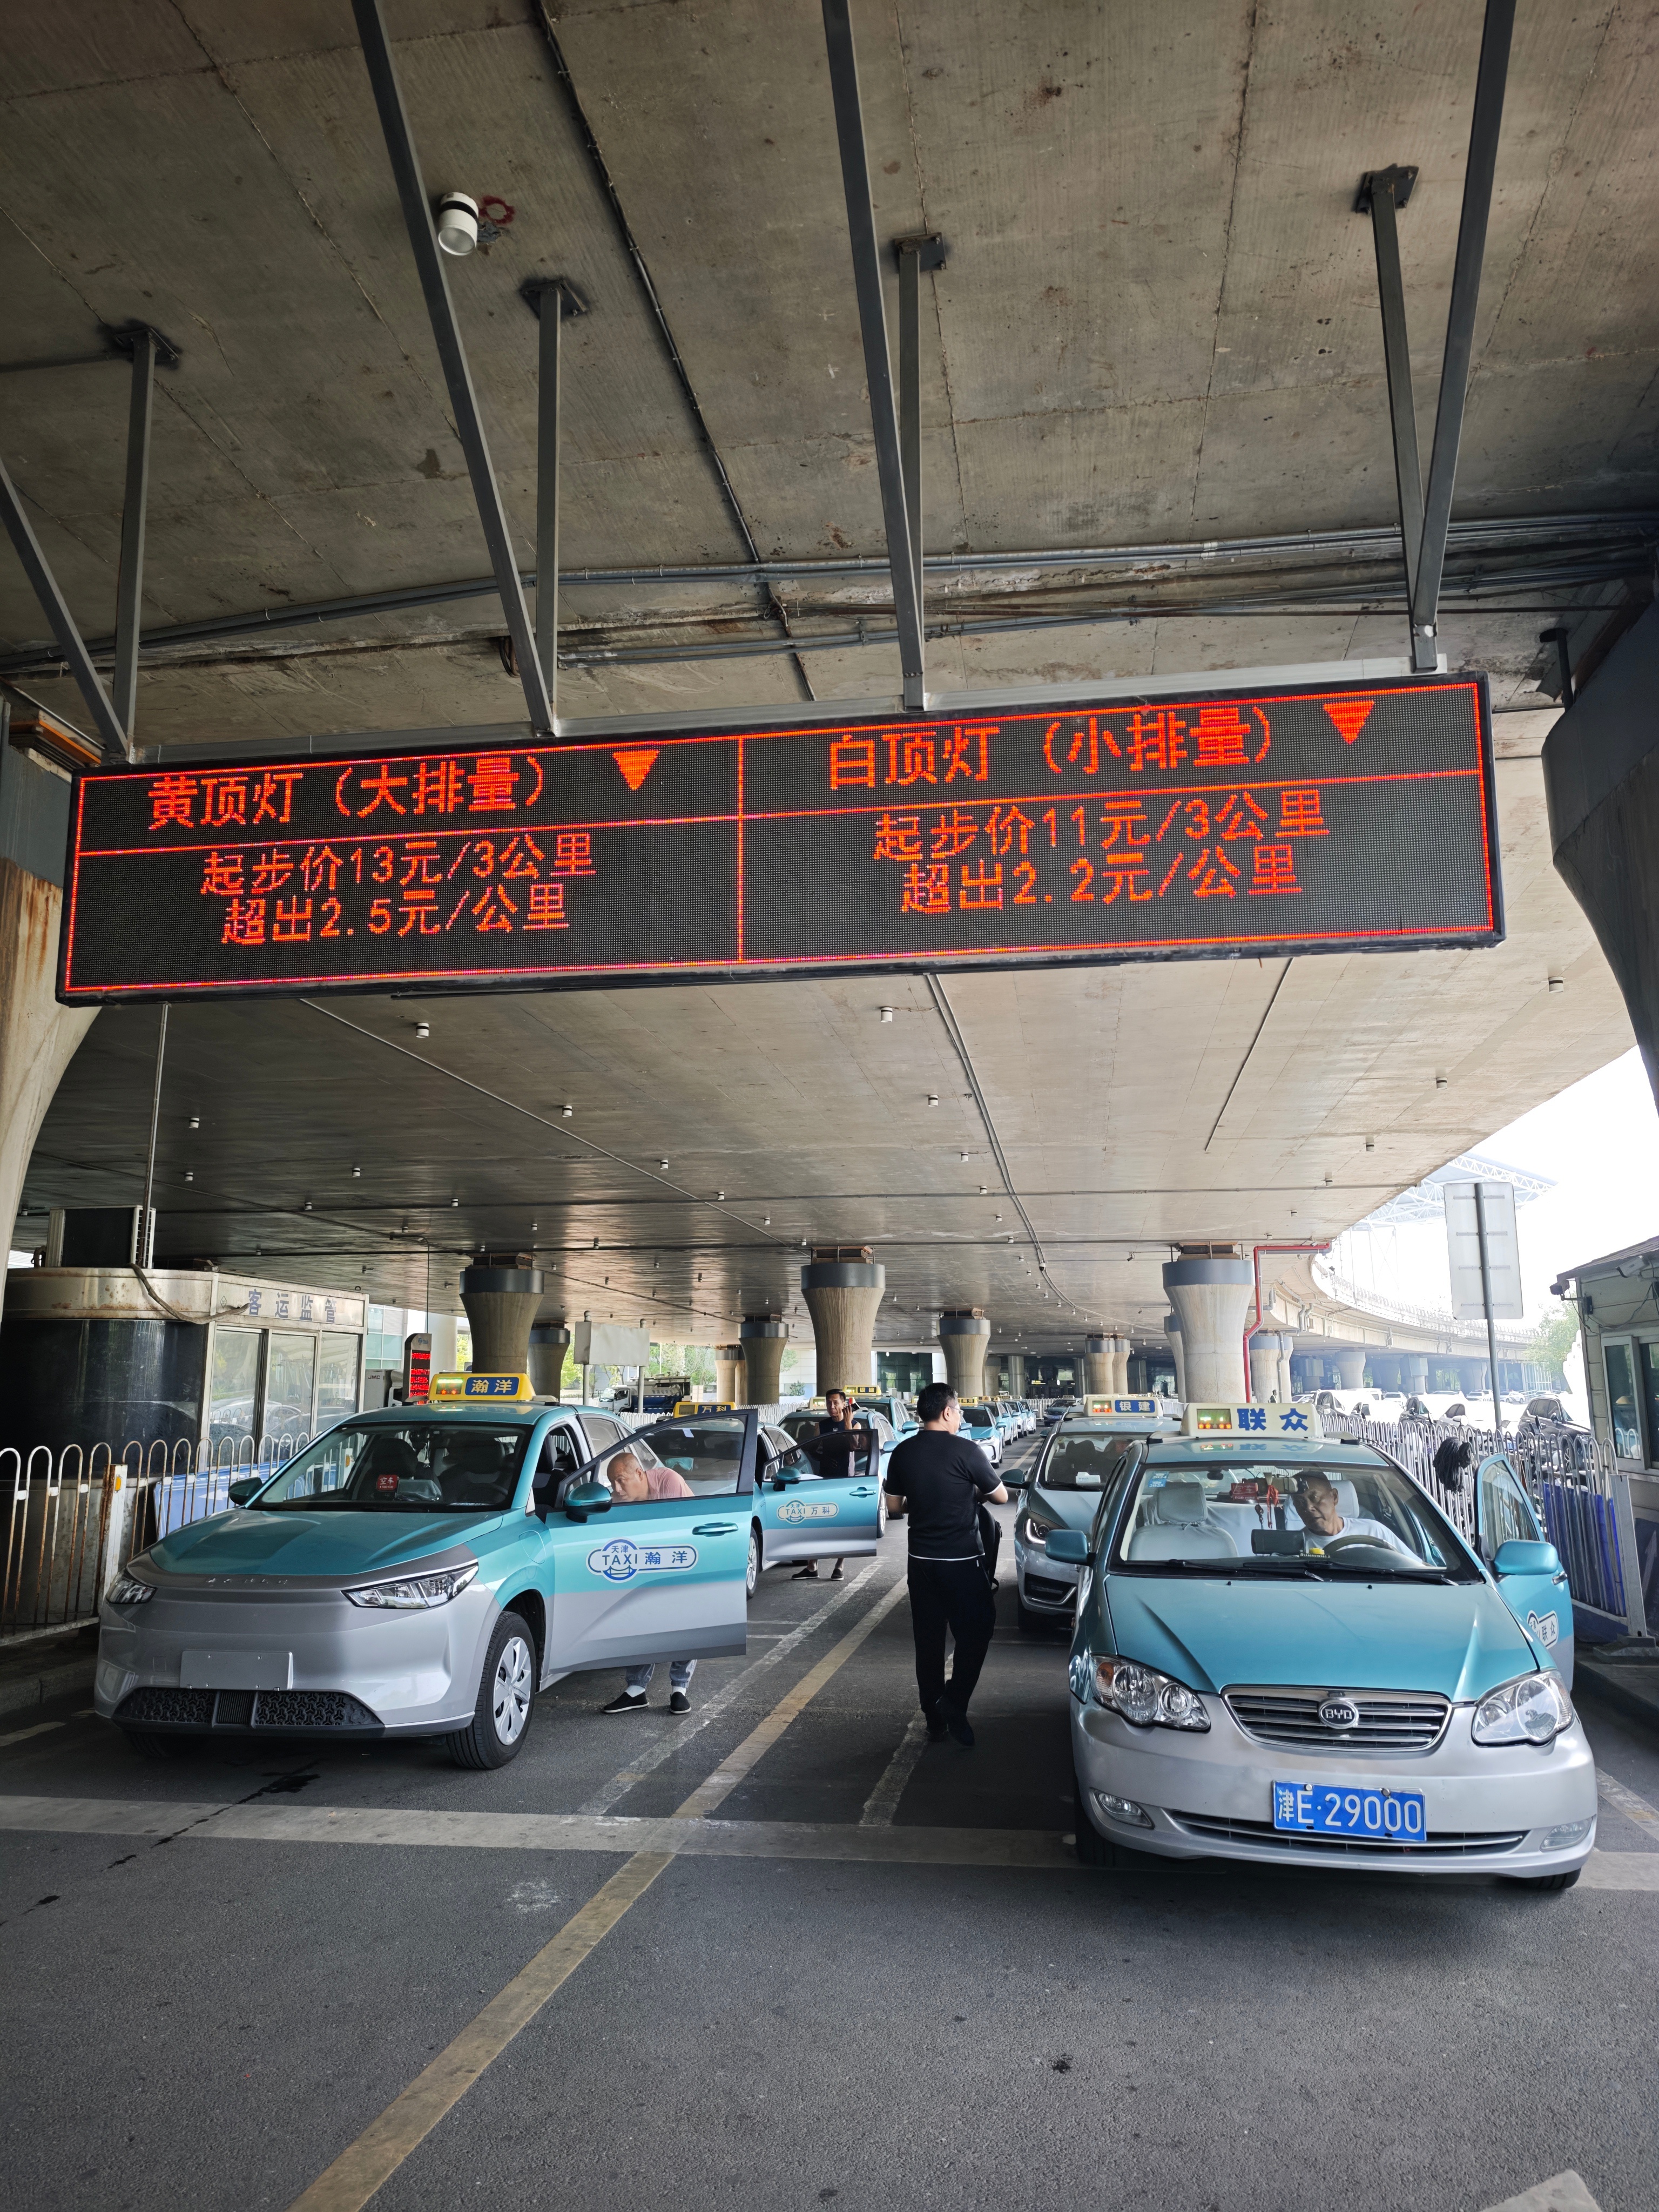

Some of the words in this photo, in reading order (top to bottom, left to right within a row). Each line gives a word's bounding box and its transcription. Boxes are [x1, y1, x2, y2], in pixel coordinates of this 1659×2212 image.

[873, 788, 1330, 862] 起步价11元/3公里
[200, 832, 597, 895] 起步价13元/3公里
[901, 844, 1303, 914] 超出2.2元/公里
[220, 884, 570, 945] 超出2.5元/公里
[248, 1289, 337, 1323] 客运监管
[471, 1379, 512, 1393] 瀚洋
[1120, 1401, 1150, 1411] 银建
[1237, 1408, 1309, 1431] 联众
[380, 1476, 394, 1486] 空车
[811, 1506, 830, 1515] 万科
[611, 1545, 629, 1554] 天津
[602, 1554, 638, 1566] TAXI
[645, 1550, 687, 1565] 瀚洋
[1325, 1709, 1352, 1719] BYD
